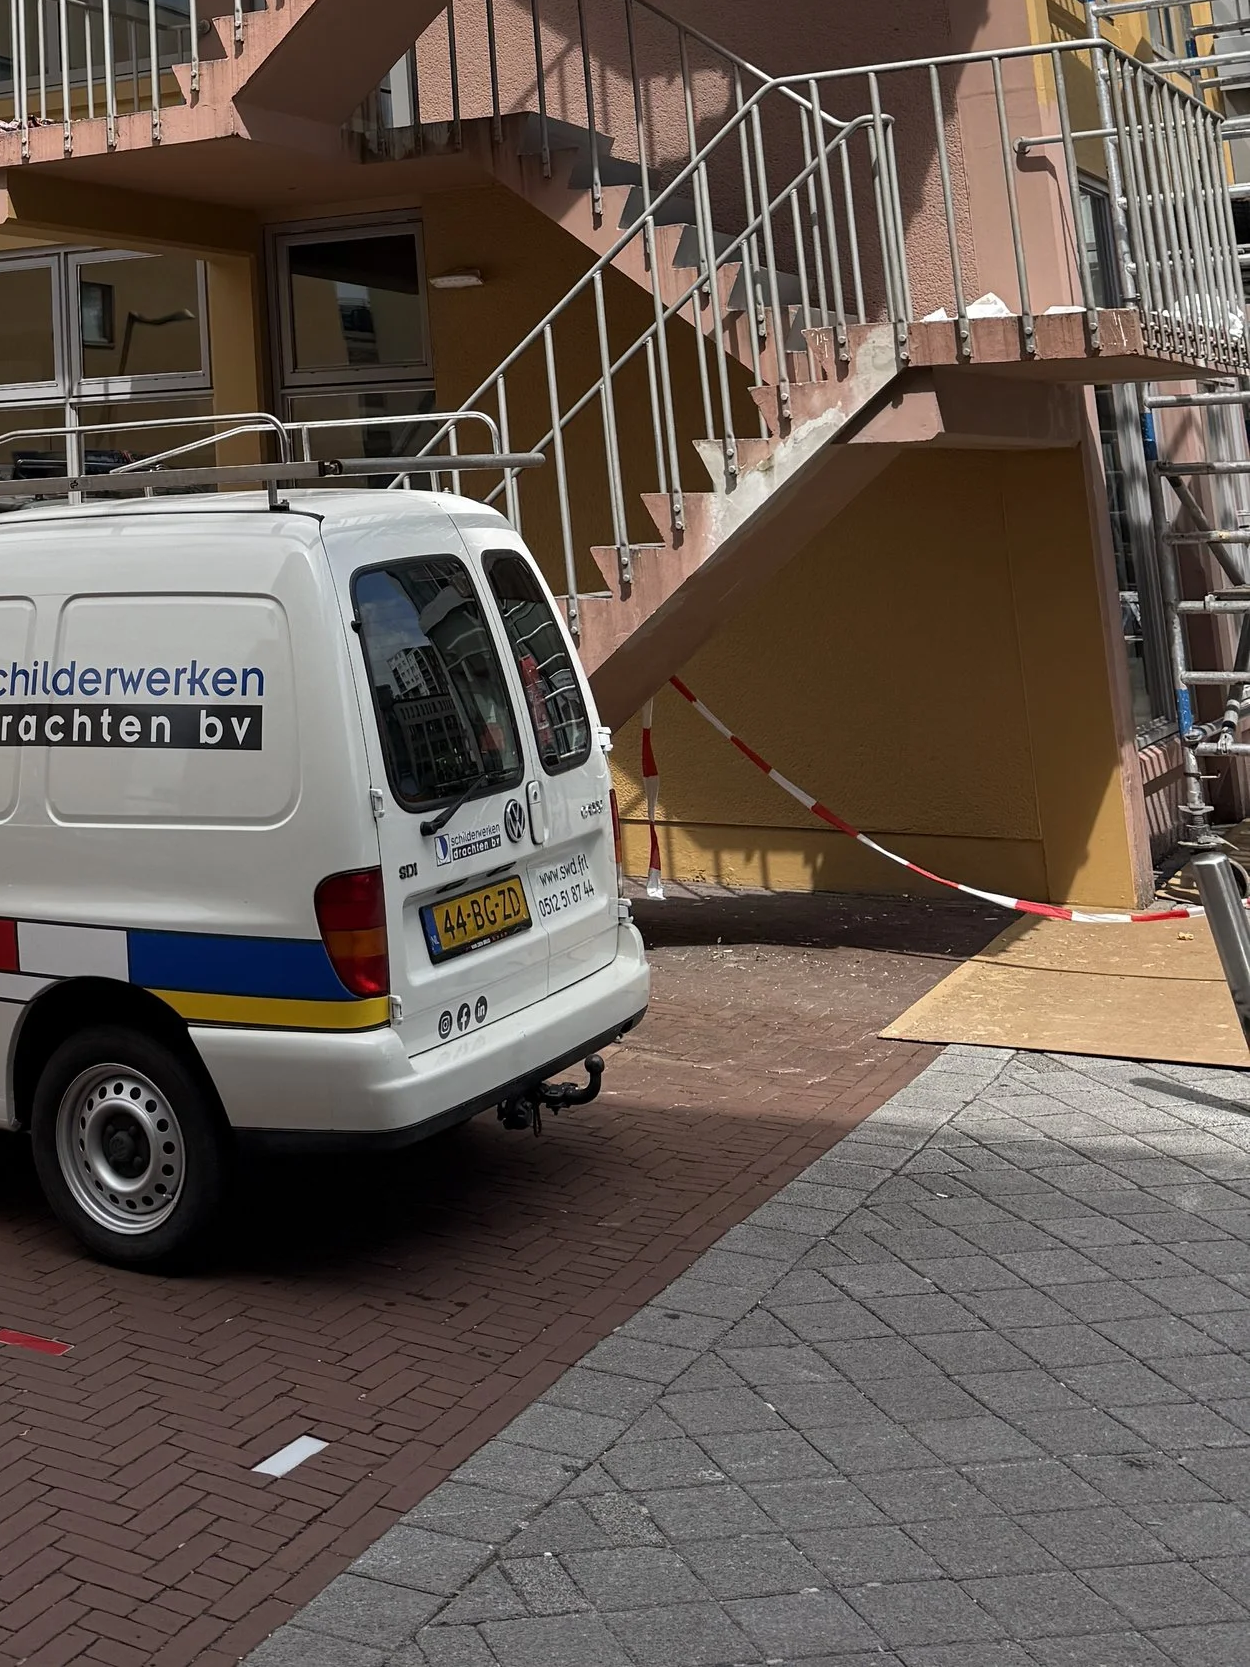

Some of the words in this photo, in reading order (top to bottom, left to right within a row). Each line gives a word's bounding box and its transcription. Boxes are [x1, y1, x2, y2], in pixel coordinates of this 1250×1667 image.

[199, 710, 252, 745] bv
[451, 823, 500, 847] schilderwerken
[453, 841, 489, 860] drachten
[491, 836, 500, 848] bv
[398, 862, 419, 880] SDI
[539, 854, 588, 886] www.swd.frl
[444, 886, 521, 941] 44-BG-ZD
[538, 894, 561, 918] 0512
[560, 889, 571, 908] 51
[571, 884, 582, 903] 87
[583, 879, 595, 897] 44
